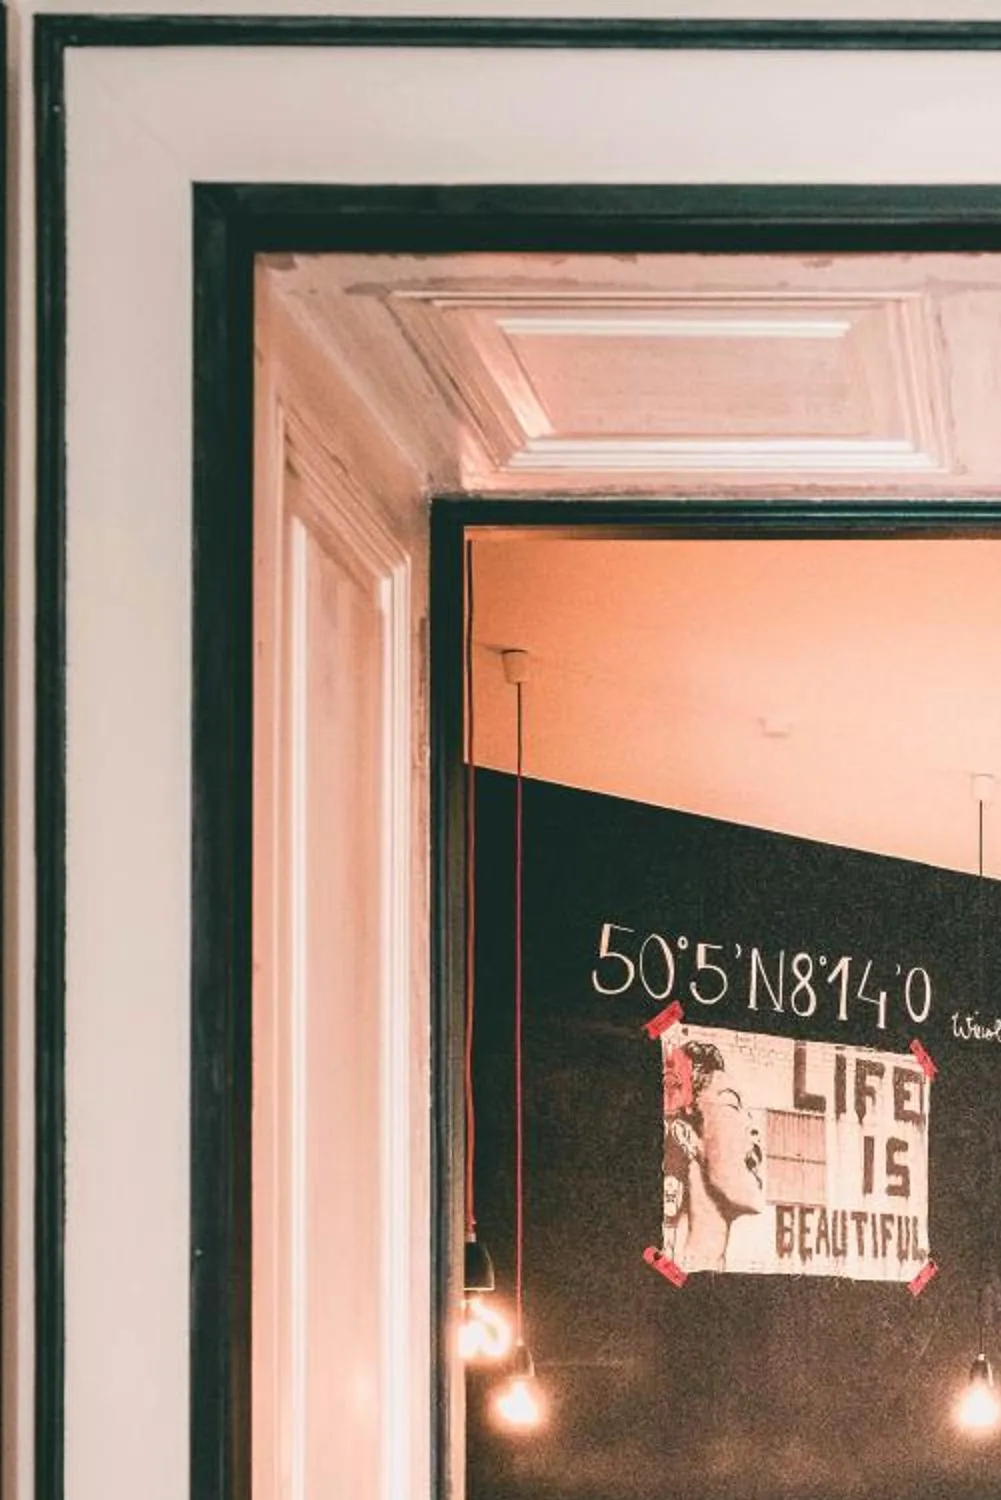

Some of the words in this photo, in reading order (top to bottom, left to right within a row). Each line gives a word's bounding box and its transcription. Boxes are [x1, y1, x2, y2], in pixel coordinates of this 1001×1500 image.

[792, 1040, 926, 1127] LIFE
[862, 1135, 911, 1198] IS
[775, 1204, 927, 1262] BEAUTIFUL
